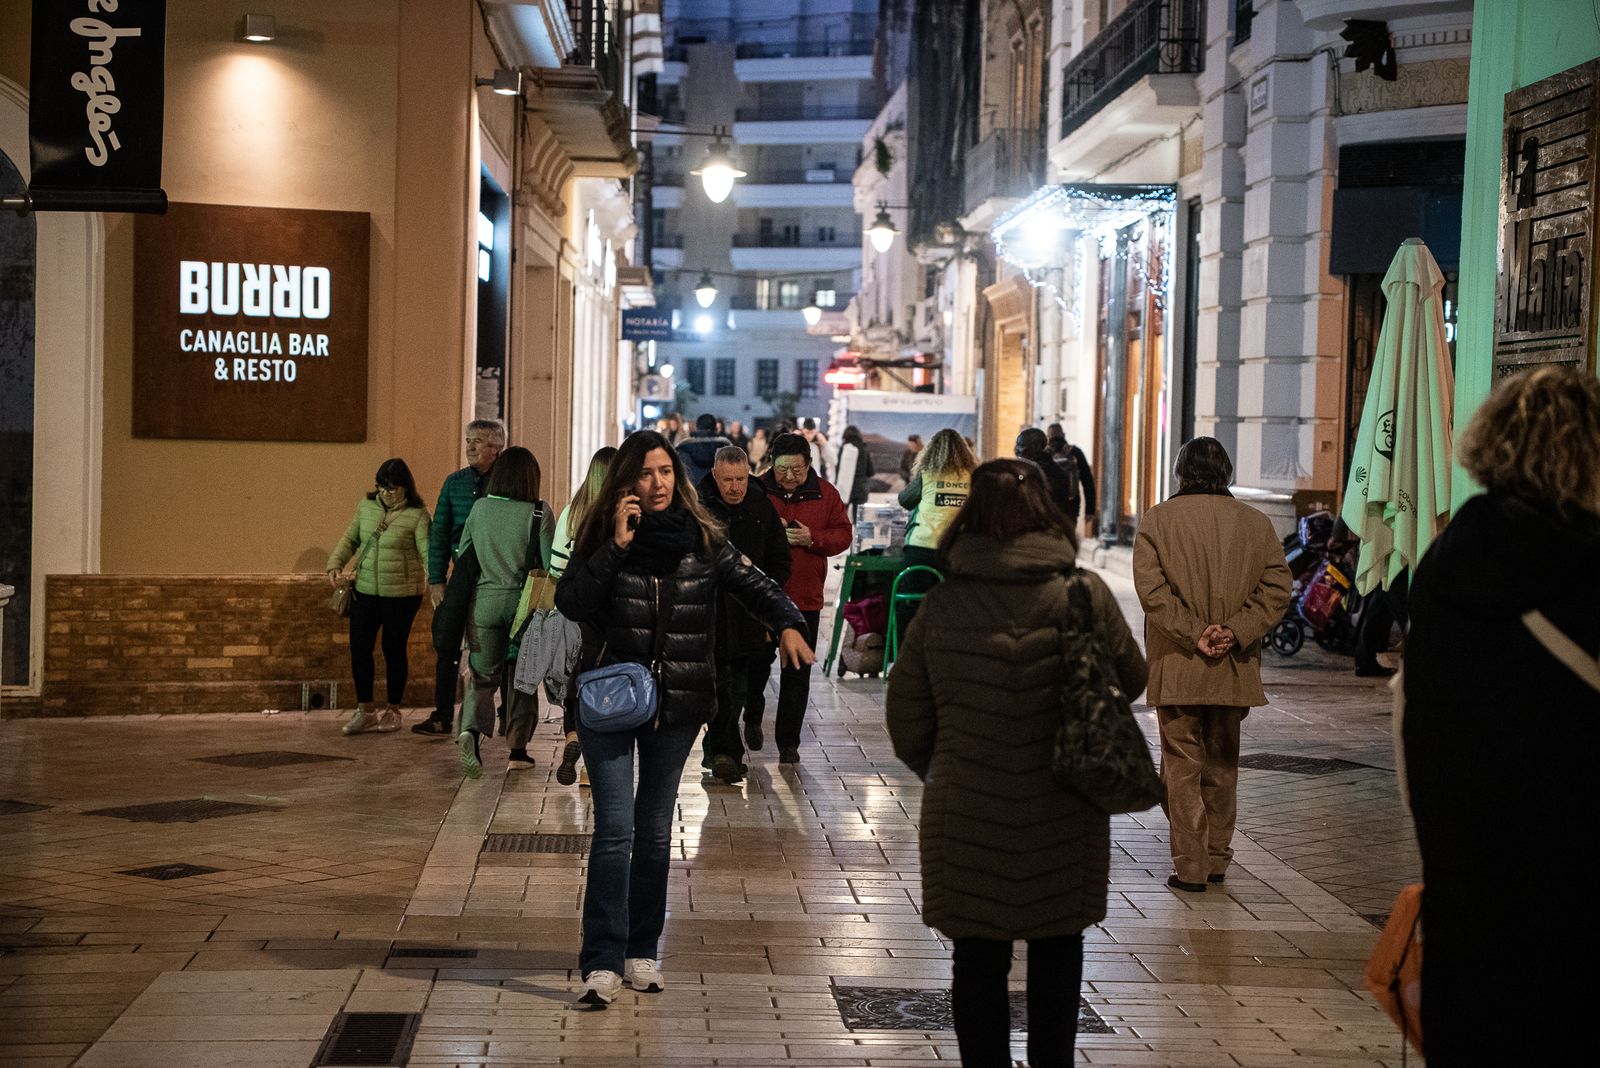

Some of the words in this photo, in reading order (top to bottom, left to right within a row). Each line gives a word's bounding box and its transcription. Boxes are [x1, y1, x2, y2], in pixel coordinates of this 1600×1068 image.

[179, 260, 331, 320] BURRO
[625, 316, 668, 327] NOTARÍA
[179, 329, 283, 356] CANAGLIA
[289, 333, 330, 357] BAR
[214, 359, 229, 381] &
[233, 359, 297, 383] RESTO
